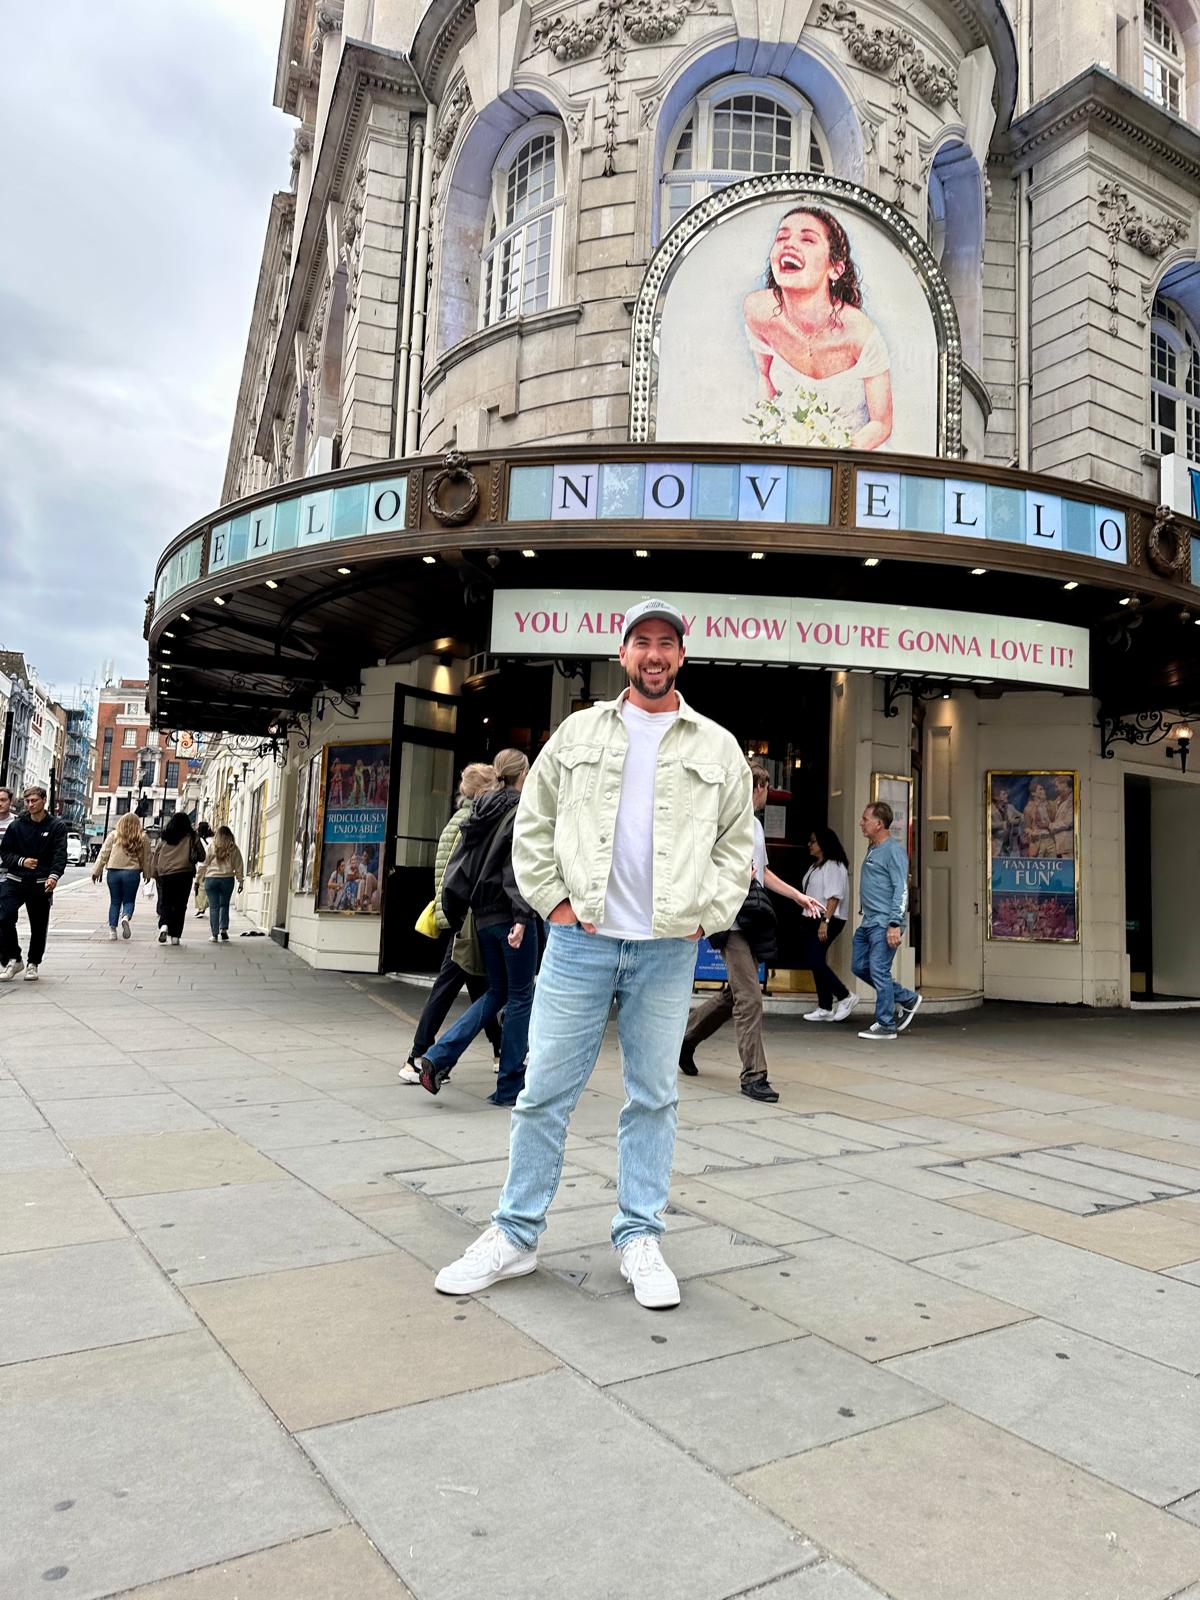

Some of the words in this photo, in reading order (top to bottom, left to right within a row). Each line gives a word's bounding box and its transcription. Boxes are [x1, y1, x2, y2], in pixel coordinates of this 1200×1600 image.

[514, 611, 568, 634] YOU
[577, 611, 697, 637] ALRY
[706, 615, 787, 641] KNOW
[796, 621, 890, 648] YOU'RE
[897, 628, 982, 657] GONNA
[990, 638, 1043, 665] LOVE
[1050, 645, 1074, 669] IT!
